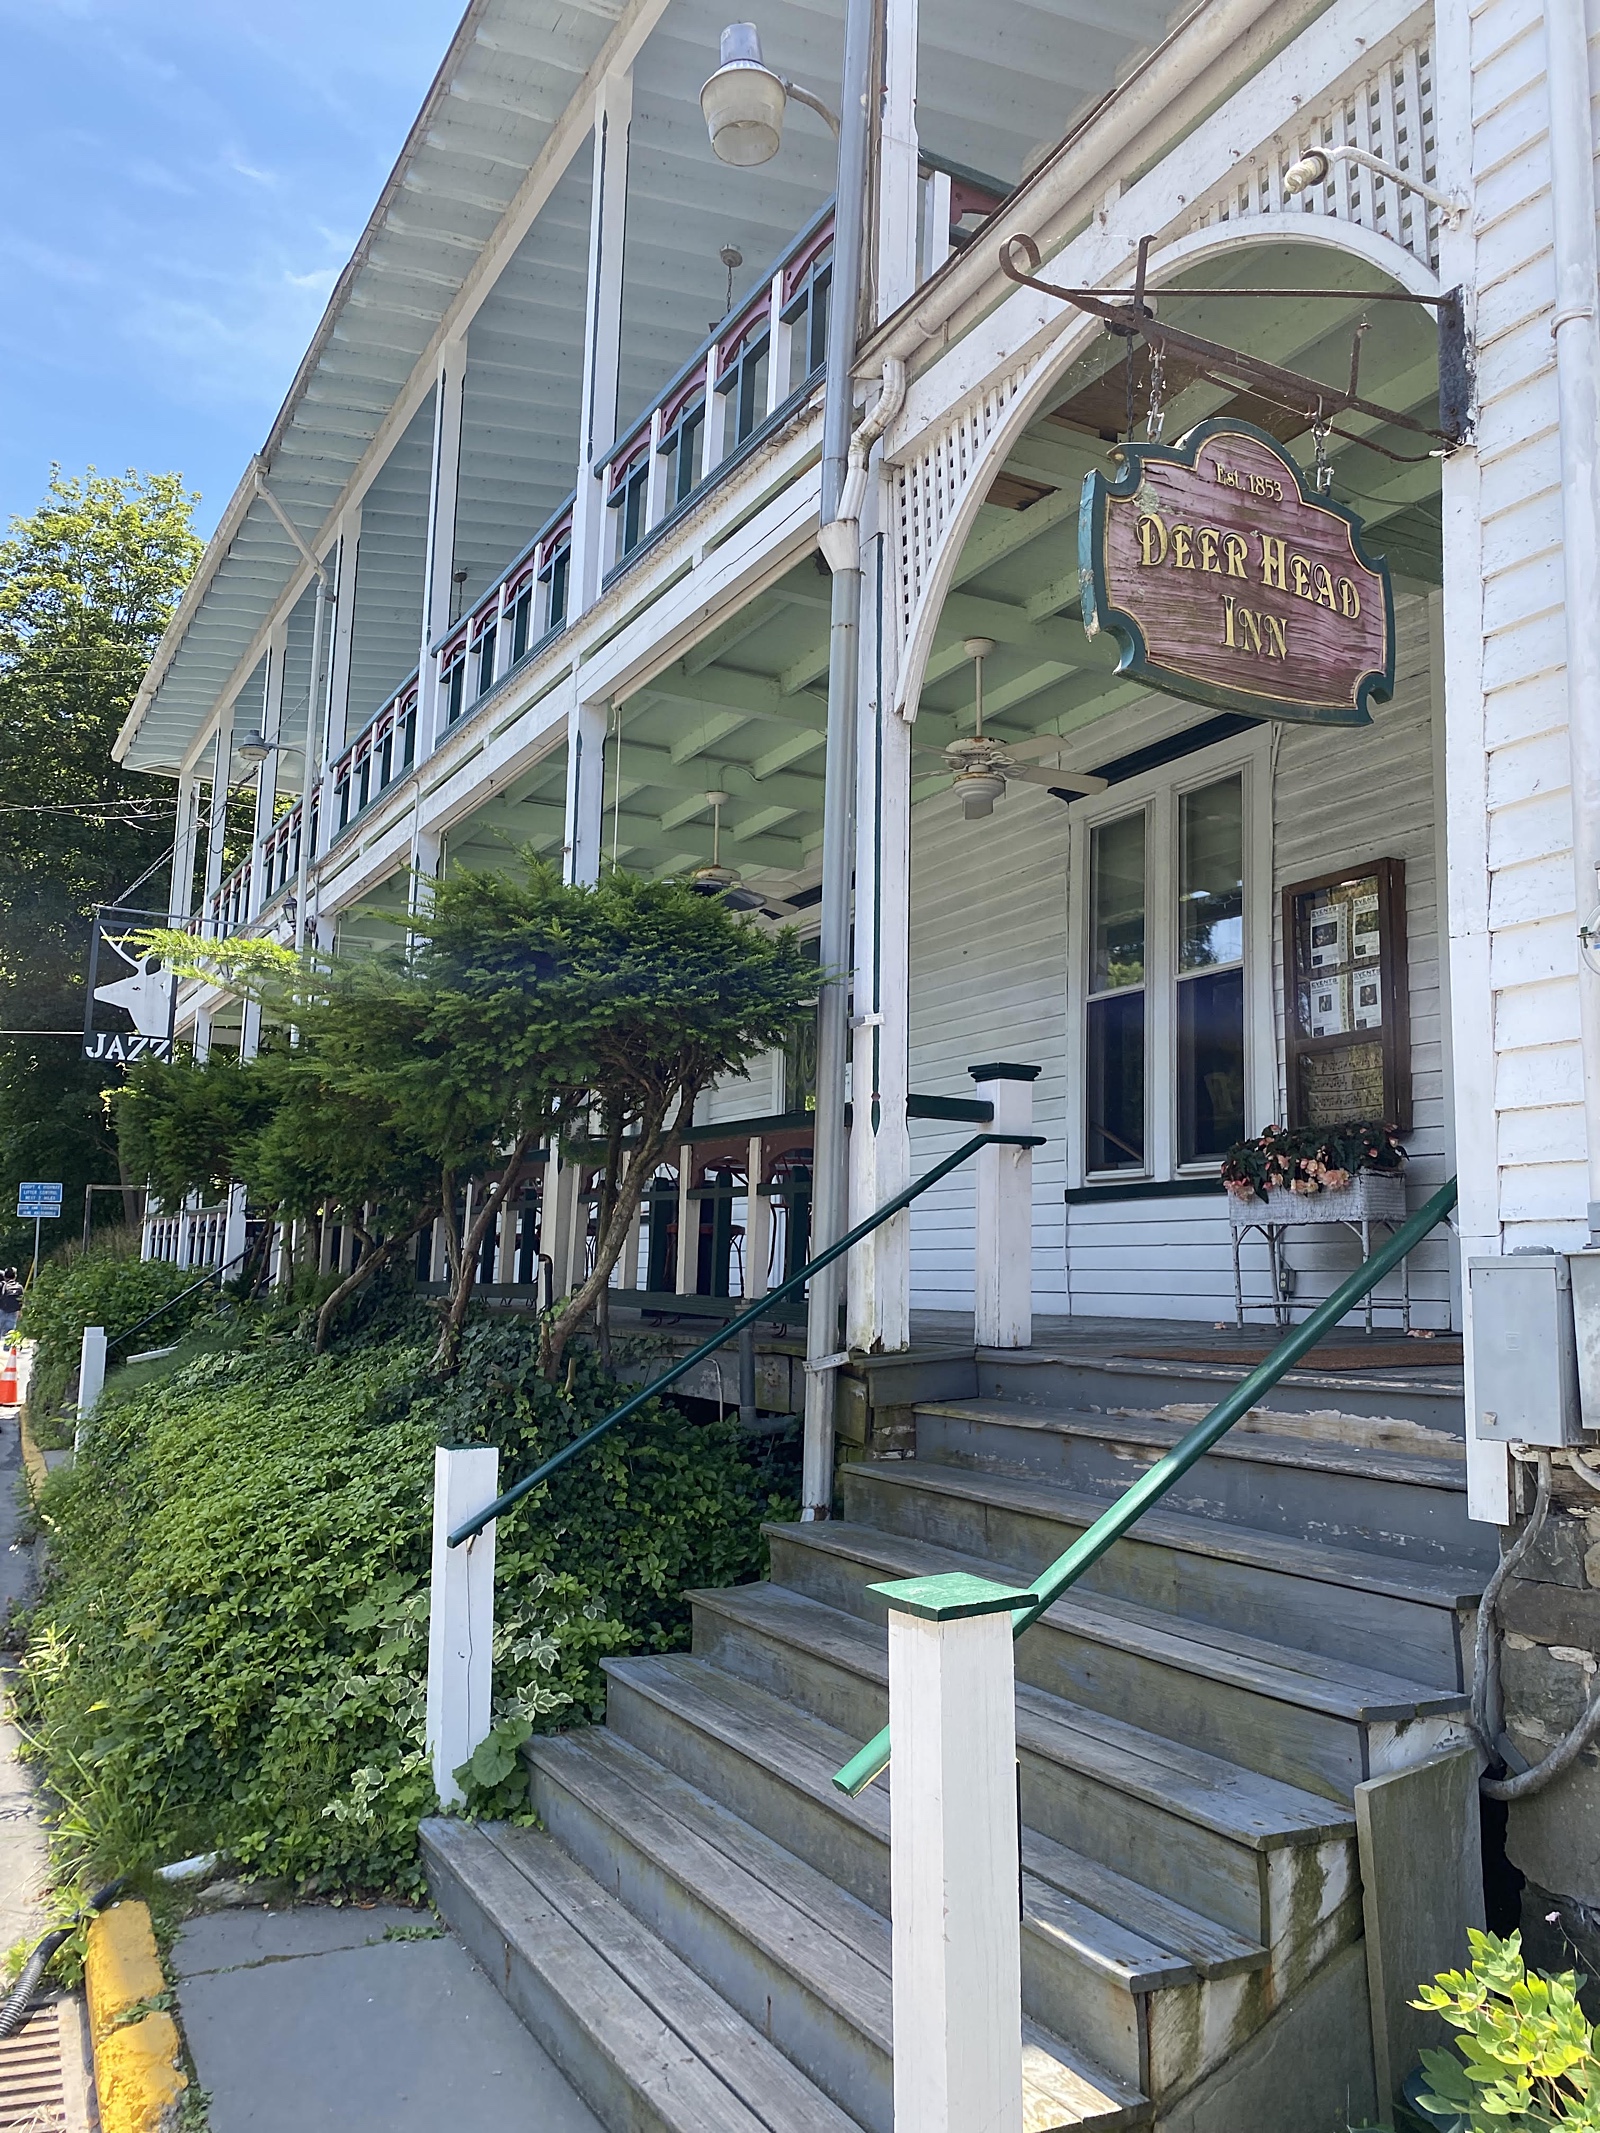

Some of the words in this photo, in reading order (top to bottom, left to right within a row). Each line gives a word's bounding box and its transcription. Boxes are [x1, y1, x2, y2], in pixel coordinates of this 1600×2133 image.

[1215, 463, 1246, 491] Est.
[1249, 474, 1283, 502] 1853
[1136, 513, 1248, 579] DEER
[1259, 533, 1361, 619] HEAD
[1221, 594, 1288, 660] INN
[85, 1033, 171, 1065] JAZZ
